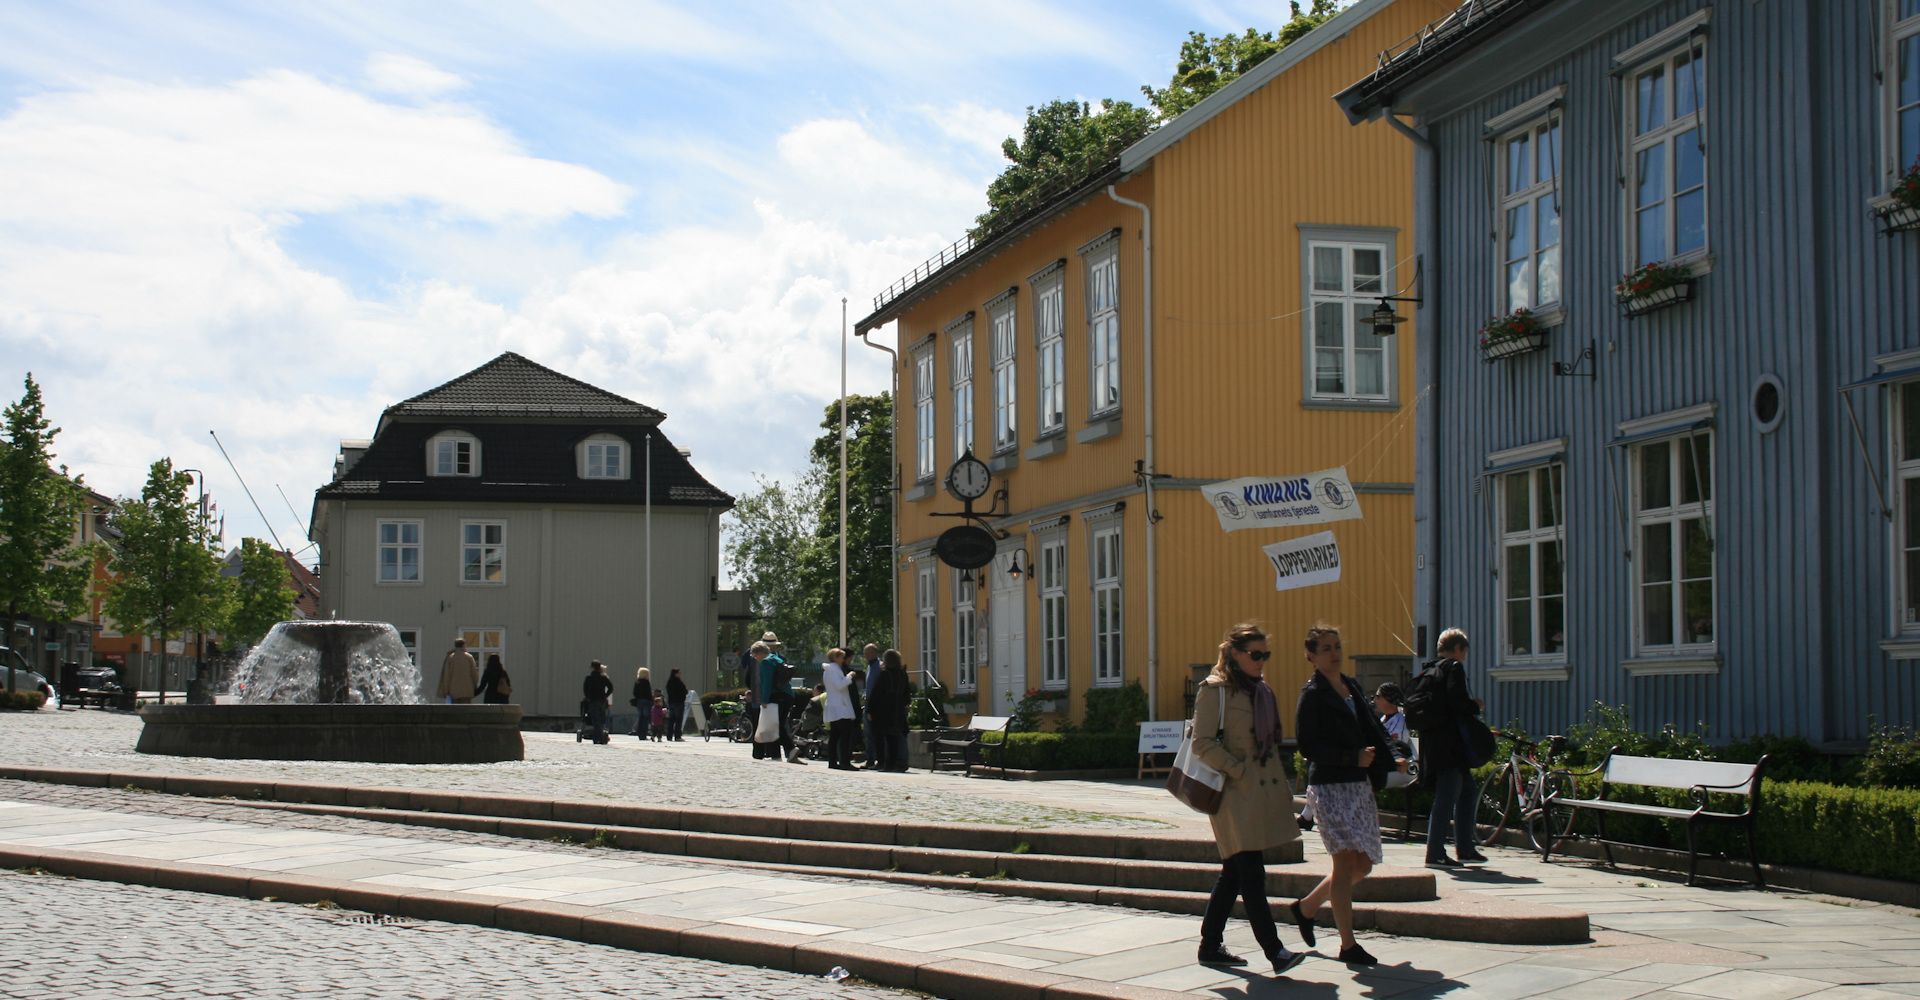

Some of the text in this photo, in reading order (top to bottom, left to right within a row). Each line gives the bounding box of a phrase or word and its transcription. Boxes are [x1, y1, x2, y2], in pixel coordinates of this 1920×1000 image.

[1243, 478, 1312, 506] KIWANIS
[1256, 507, 1293, 520] samfunnets
[1291, 503, 1320, 519] tjeneste
[1271, 543, 1339, 578] LOPPEMARKED
